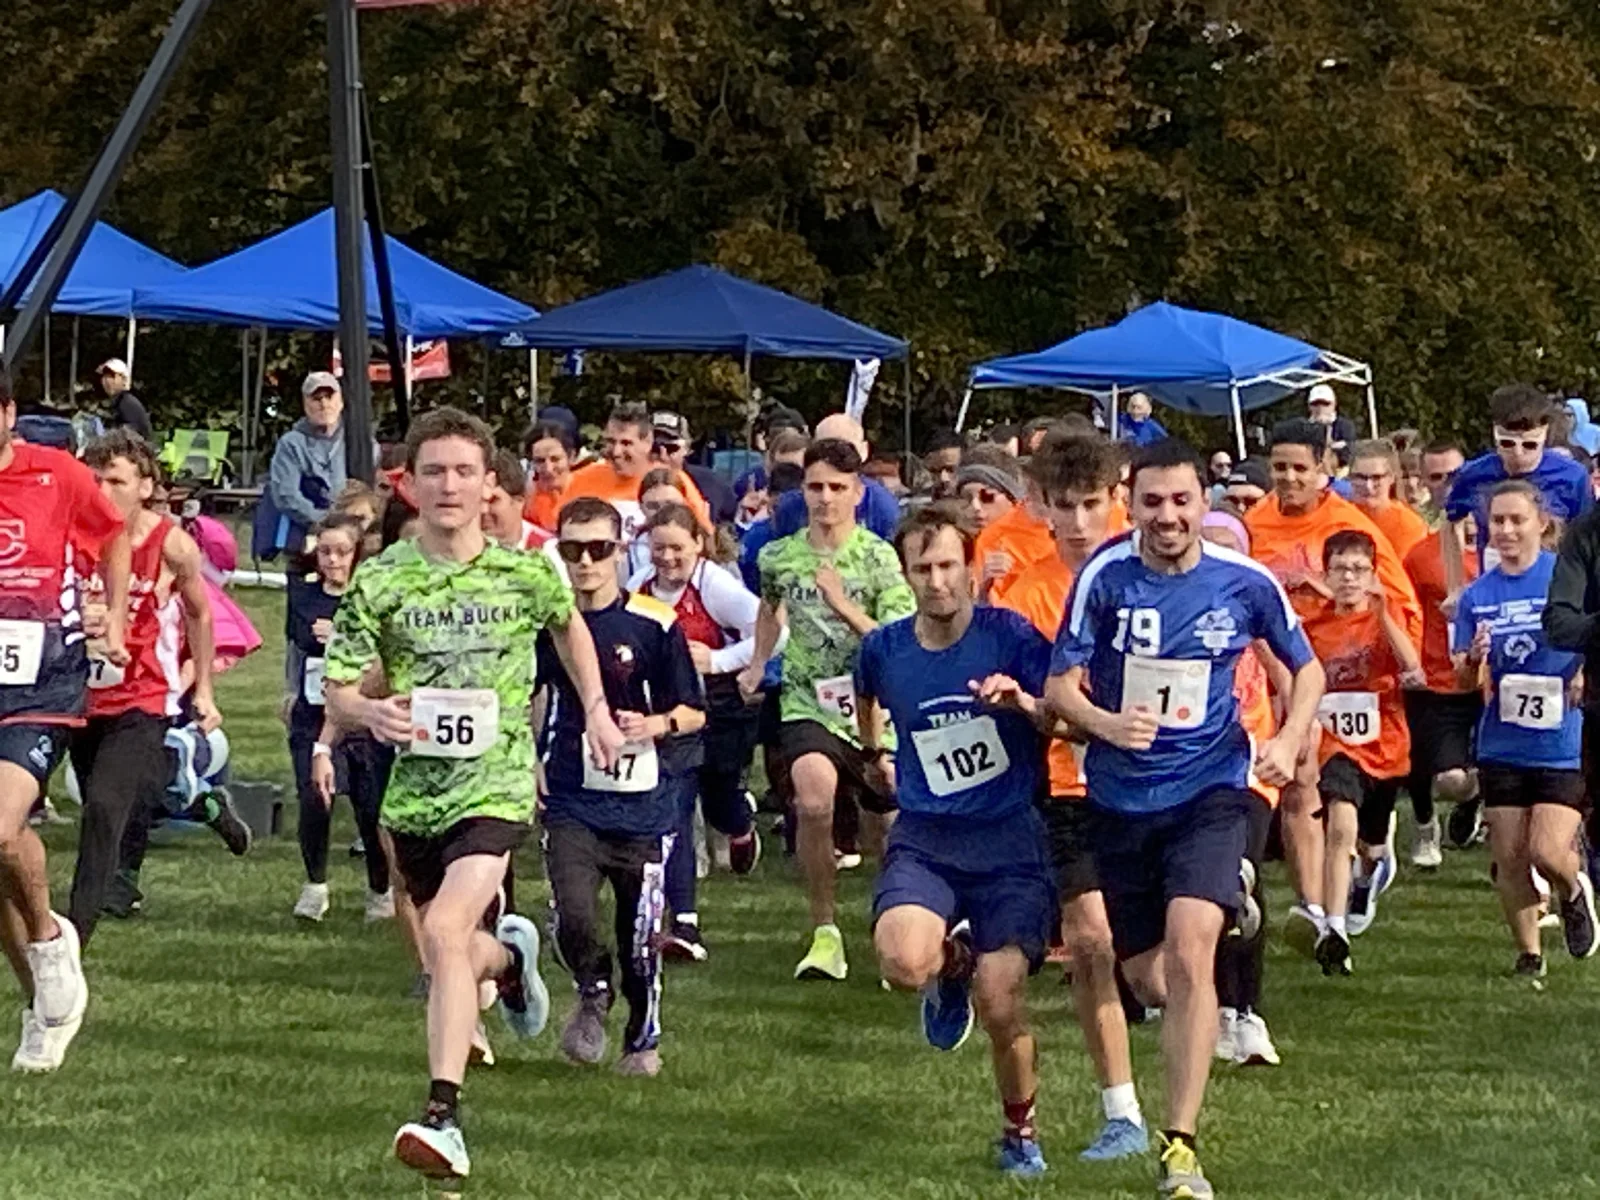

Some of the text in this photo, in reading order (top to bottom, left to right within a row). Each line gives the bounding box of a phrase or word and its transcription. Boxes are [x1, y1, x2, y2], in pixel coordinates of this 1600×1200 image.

[402, 608, 455, 628] TEAM
[1157, 685, 1171, 716] 1
[1516, 693, 1544, 720] 73
[436, 714, 474, 746] 56
[1329, 712, 1369, 737] 130
[935, 741, 996, 782] 102
